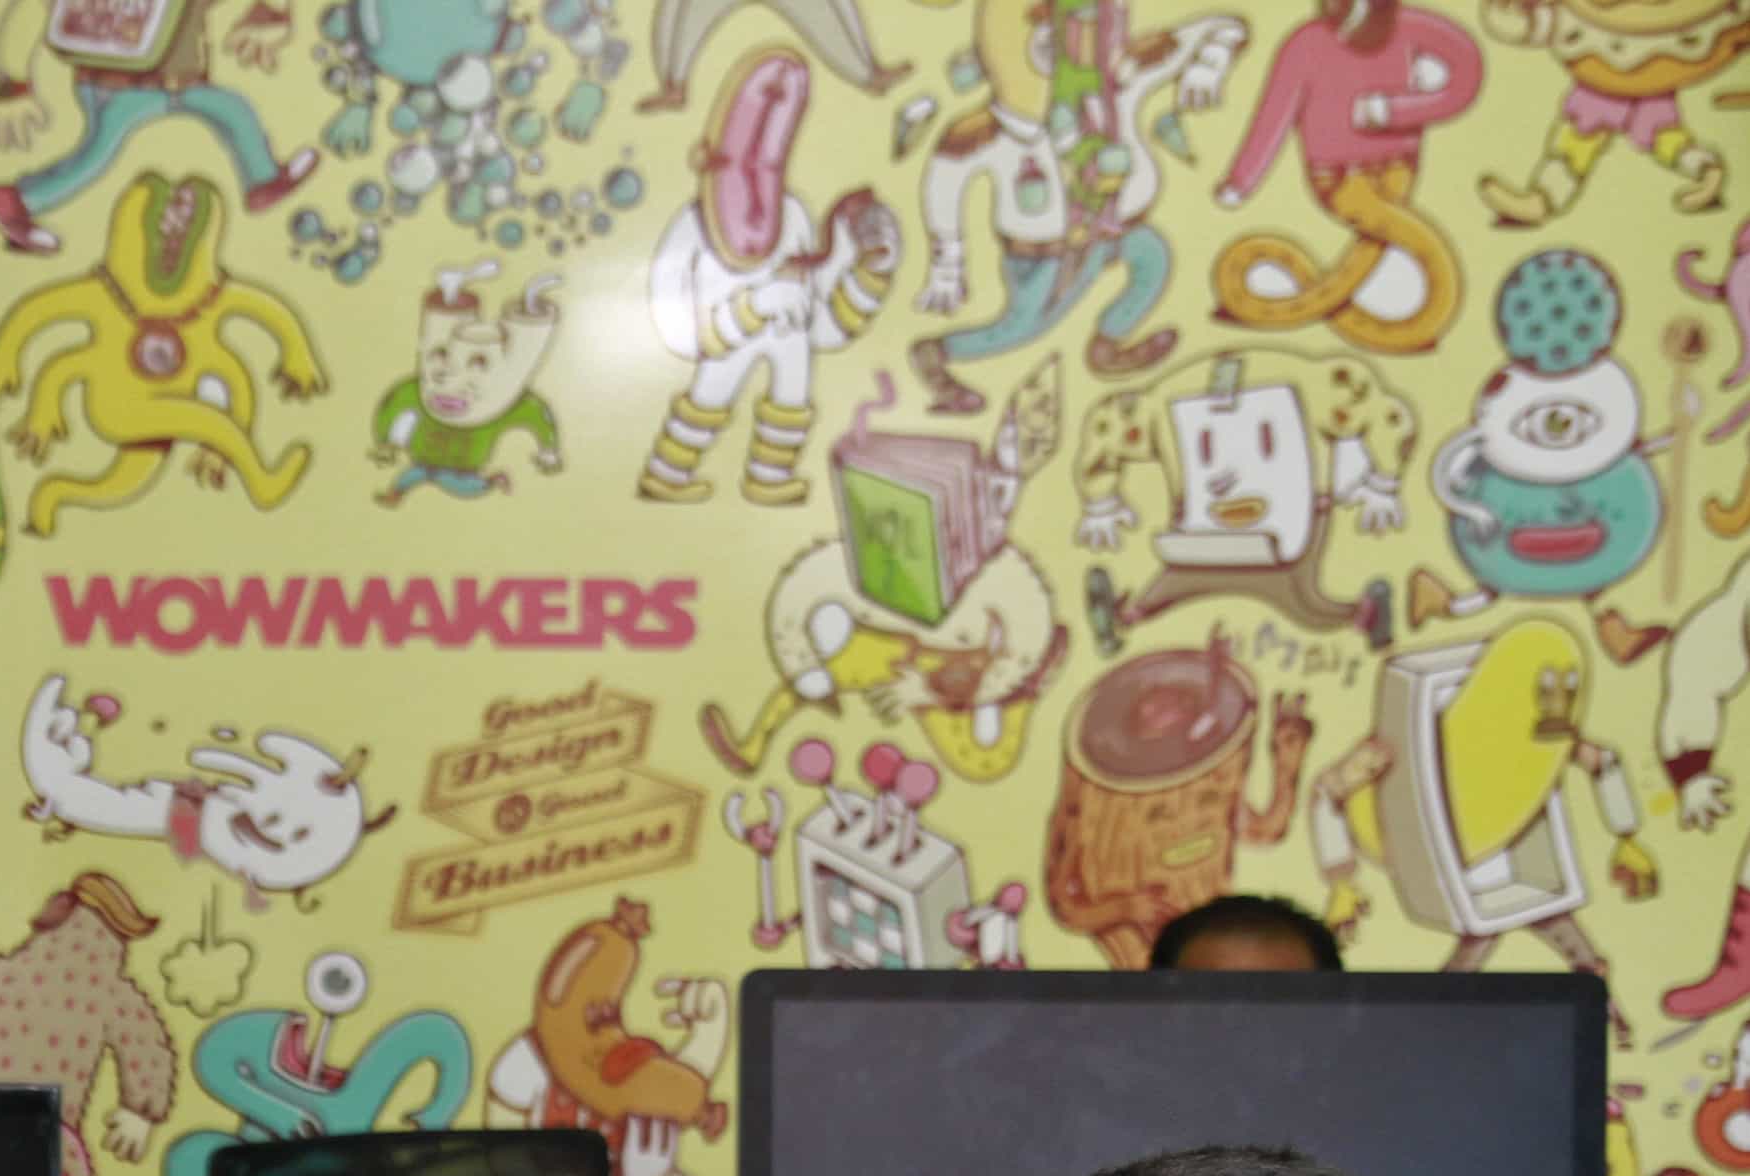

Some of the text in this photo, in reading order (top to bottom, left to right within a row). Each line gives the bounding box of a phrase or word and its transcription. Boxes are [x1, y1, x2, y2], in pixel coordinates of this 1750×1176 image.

[45, 575, 698, 654] WOWMAKERS
[484, 679, 596, 730] Good
[453, 728, 620, 785] Design
[539, 780, 625, 817] Good
[423, 823, 671, 901] Business
